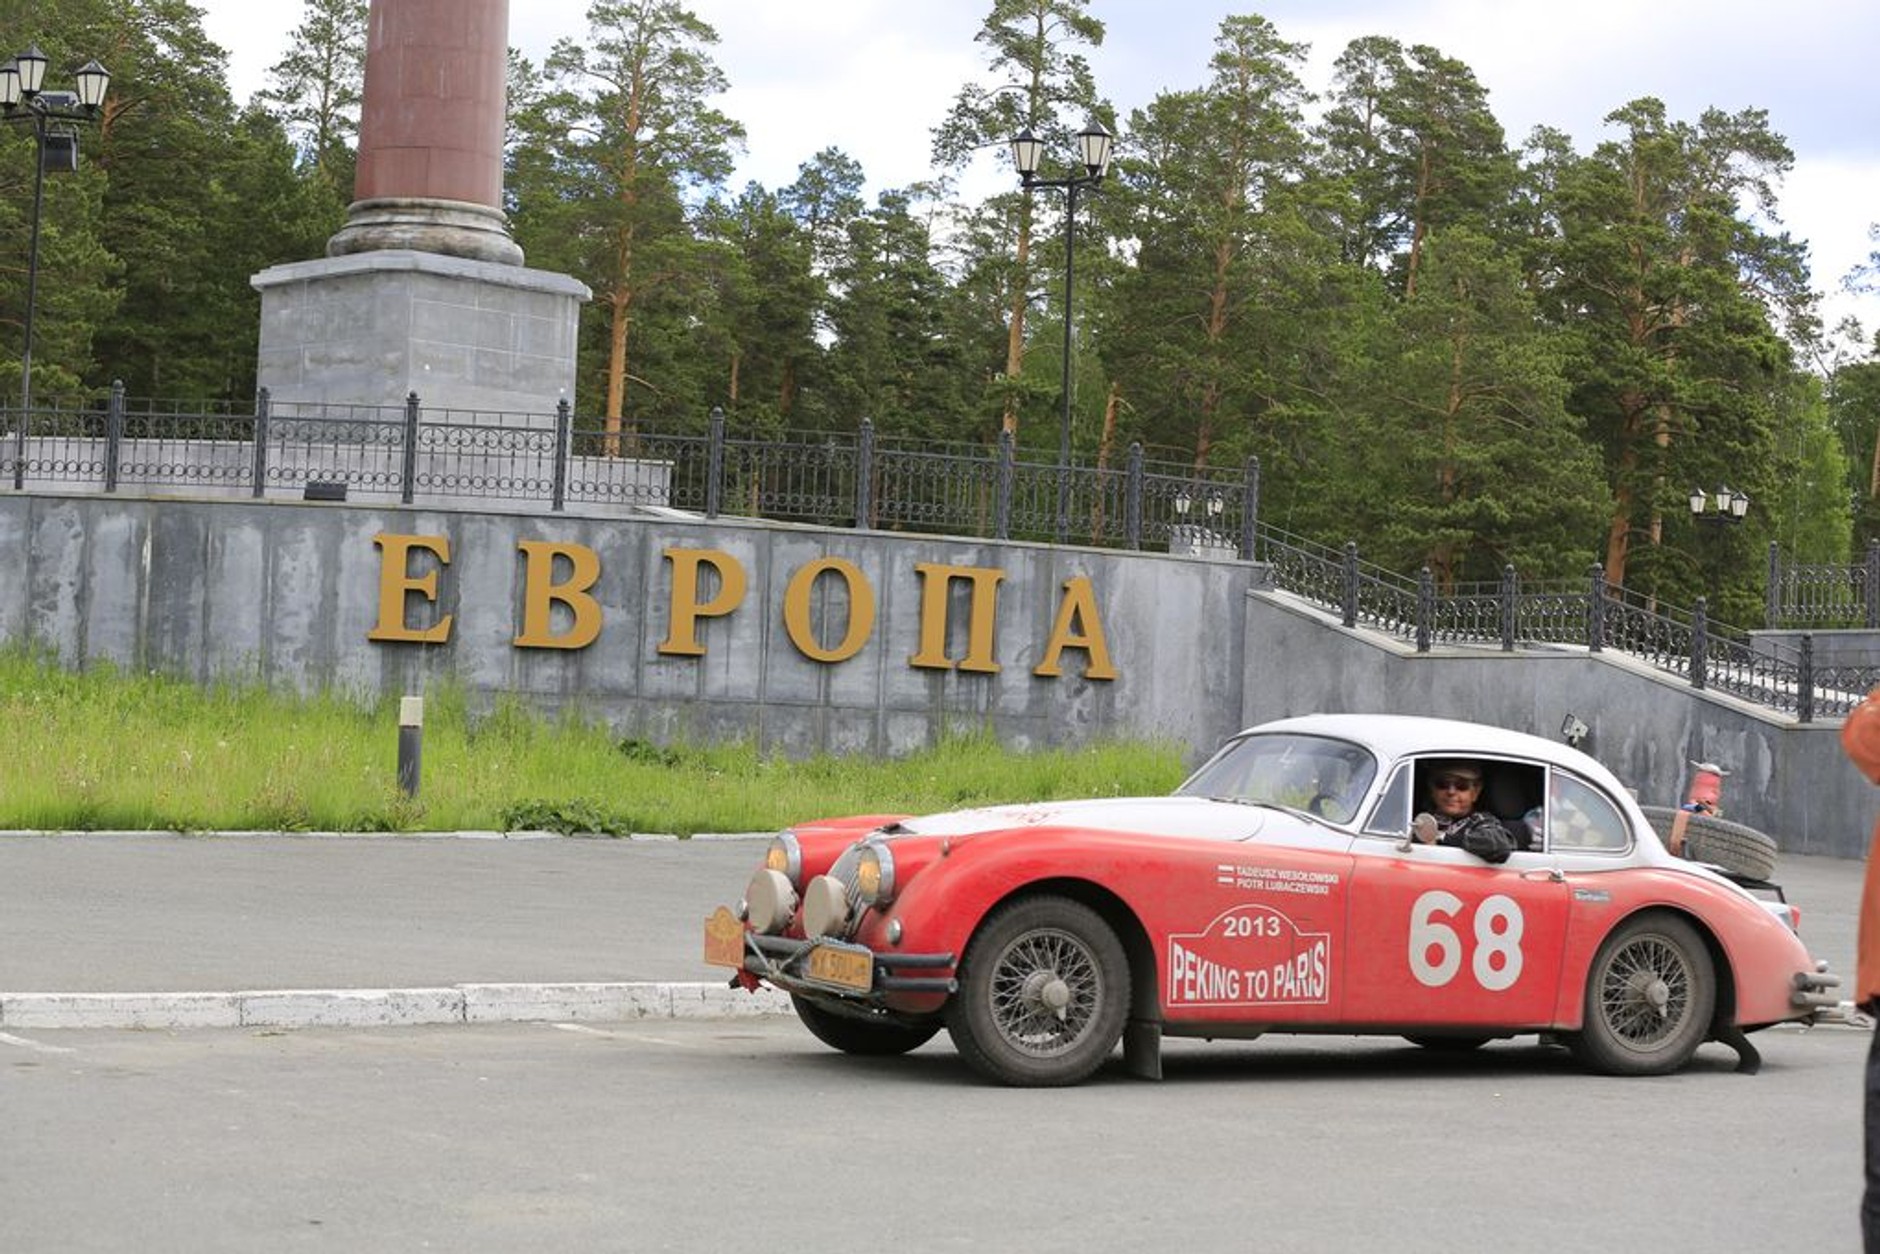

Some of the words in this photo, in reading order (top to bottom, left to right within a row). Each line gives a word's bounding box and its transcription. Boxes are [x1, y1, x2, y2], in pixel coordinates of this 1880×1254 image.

[369, 532, 1119, 680] ЕВРОПА
[1236, 866, 1278, 879] TADEUSZ
[1236, 878, 1264, 889] PIOTR
[1223, 916, 1281, 937] 2013
[1408, 890, 1524, 991] 68
[1172, 942, 1240, 1000] PEKING
[1245, 969, 1269, 999] TO
[1273, 940, 1326, 999] PARIS
